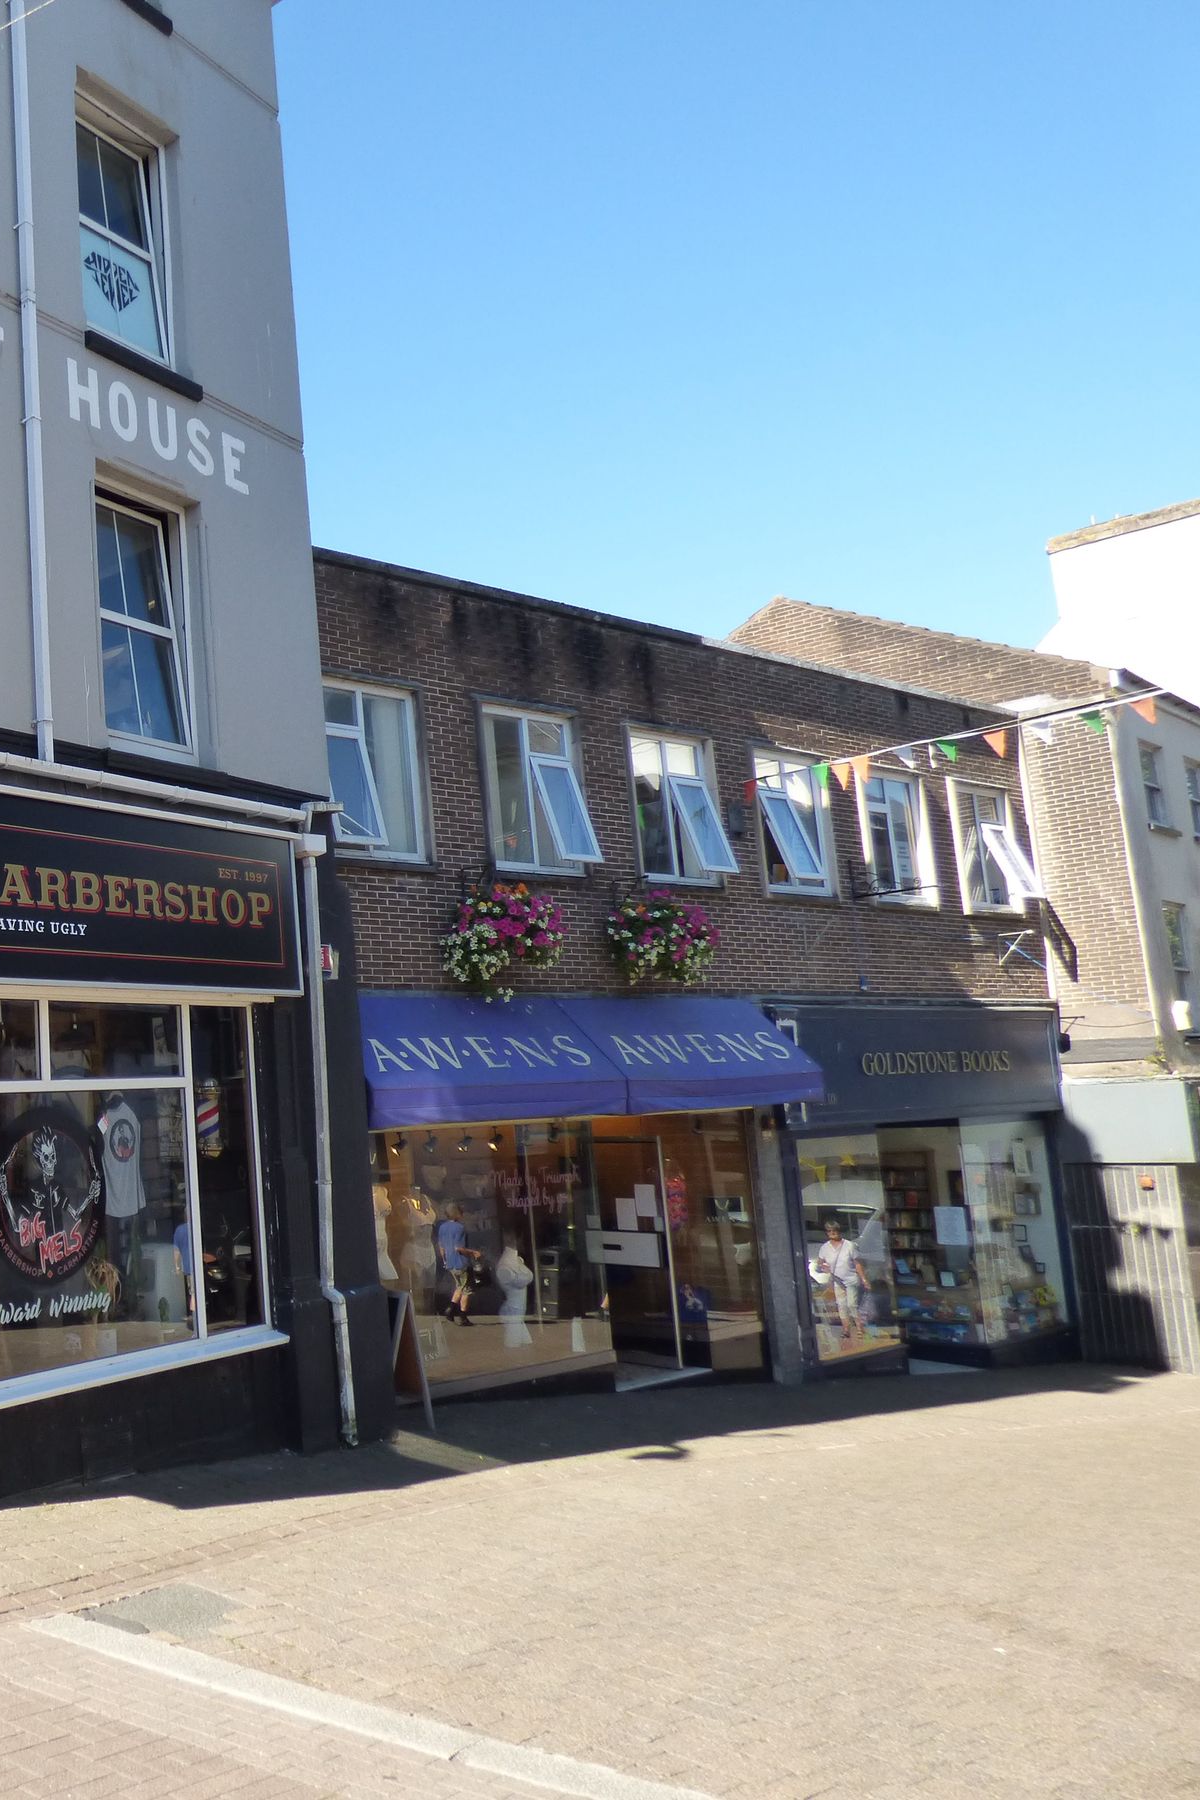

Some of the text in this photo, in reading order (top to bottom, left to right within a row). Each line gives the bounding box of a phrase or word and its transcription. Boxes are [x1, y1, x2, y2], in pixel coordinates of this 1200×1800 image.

[66, 357, 249, 496] HOUSE
[218, 867, 268, 884] EST. 1997
[50, 922, 88, 937] UGLY
[862, 1050, 1010, 1076] GOLDSTONE BOOKS
[19, 1211, 46, 1248] BIG
[39, 1219, 83, 1274] MELS
[57, 1219, 100, 1275] CARMARTHEN
[49, 1291, 112, 1317] Winning
